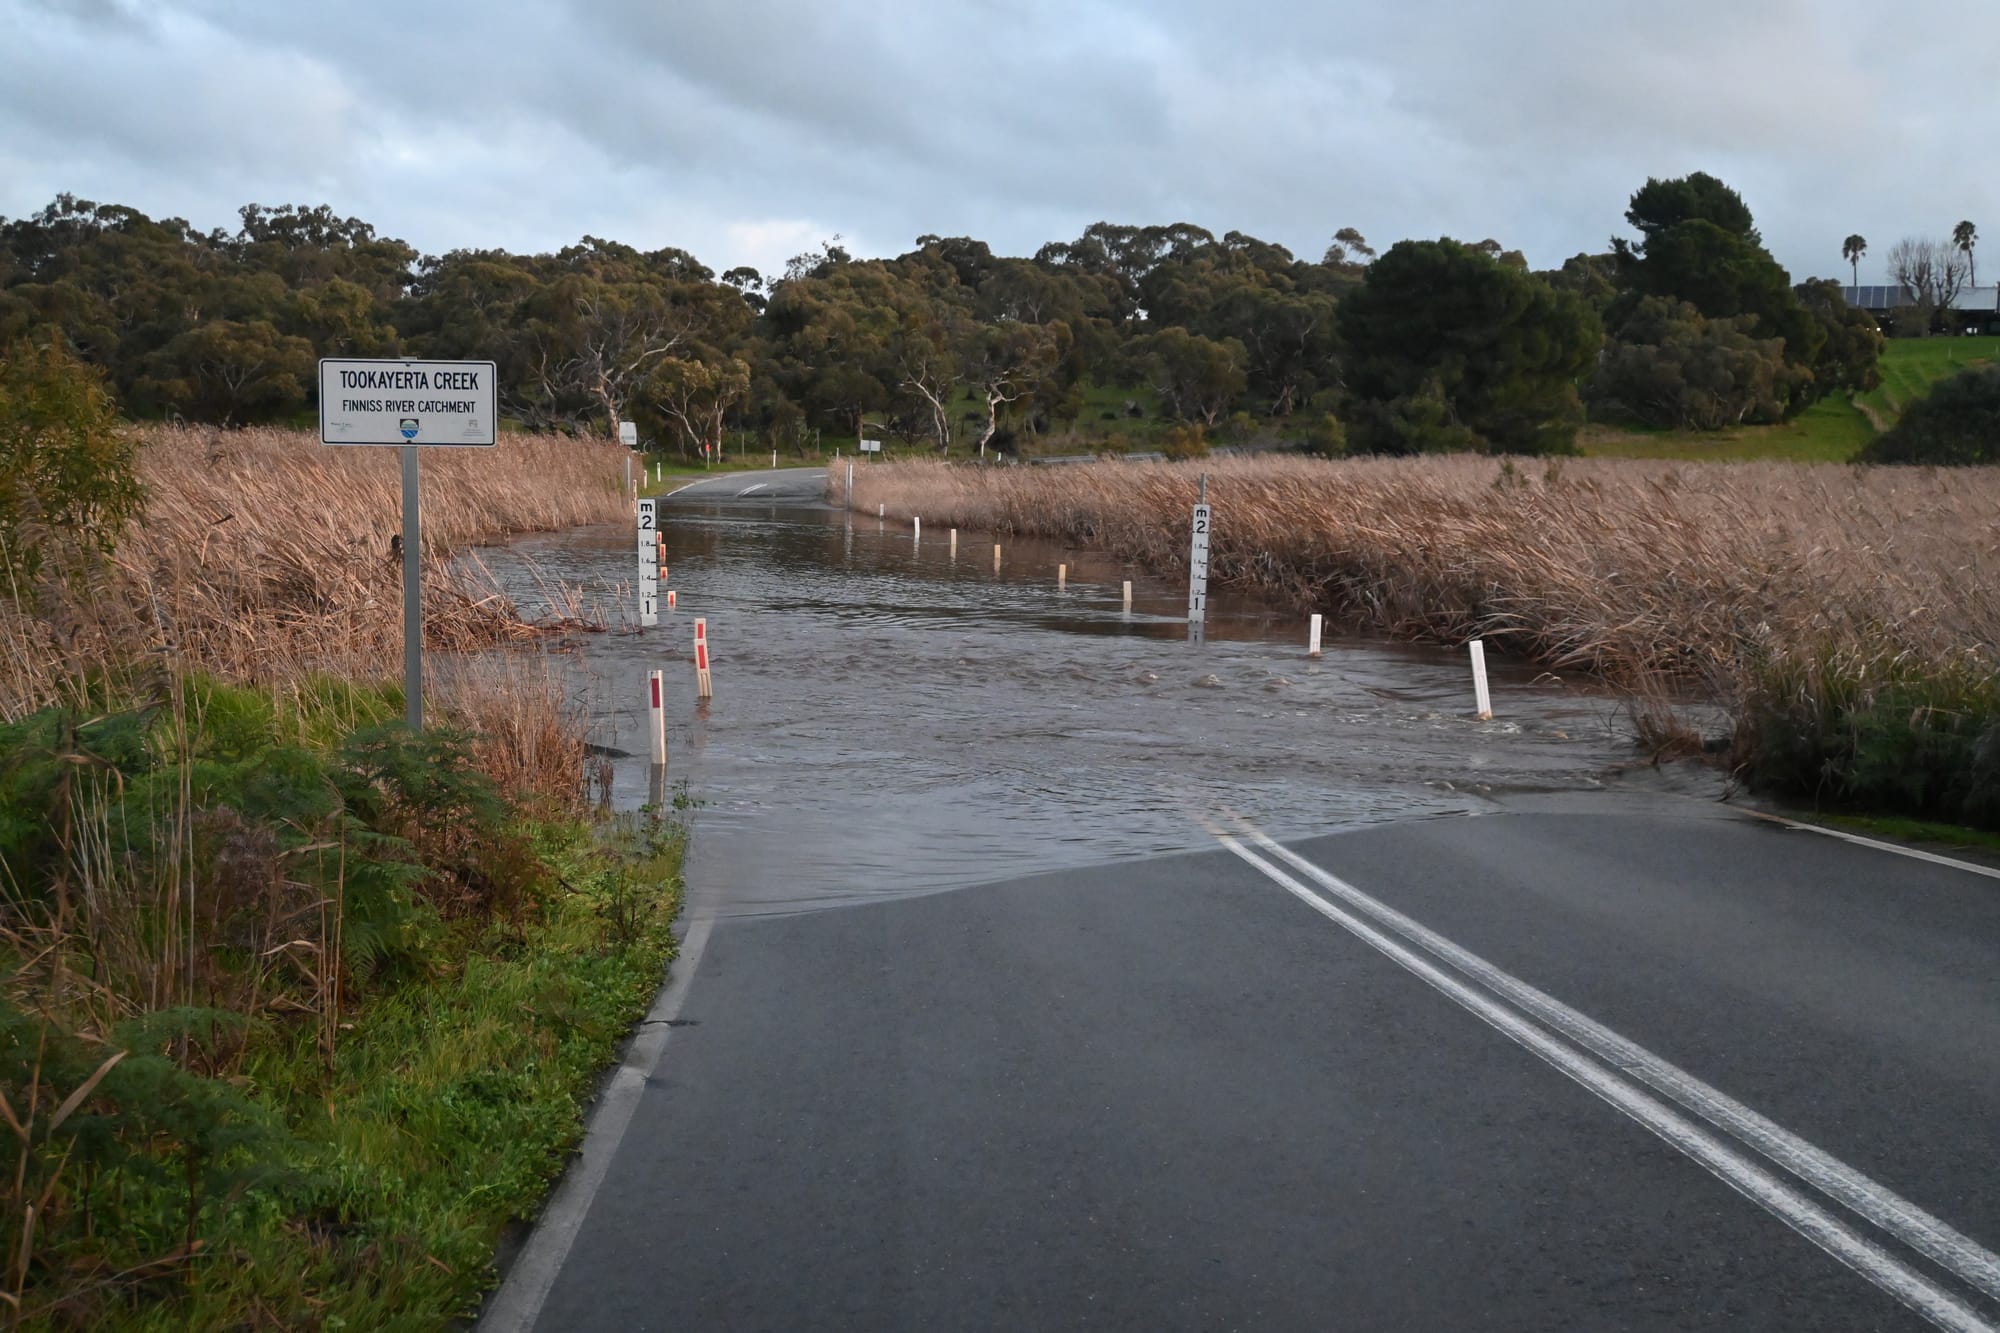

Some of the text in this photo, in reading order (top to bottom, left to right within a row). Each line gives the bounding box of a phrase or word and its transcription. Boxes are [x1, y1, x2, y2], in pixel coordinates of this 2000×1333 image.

[340, 370, 479, 390] TOOKAYERTA CREEK
[342, 400, 476, 413] FINNISS RIVER CATCHMENT
[641, 503, 652, 512] m
[1196, 509, 1207, 517] m
[642, 515, 652, 530] 2
[1196, 520, 1206, 534] 2
[645, 600, 650, 614] 1
[1194, 597, 1199, 610] 1
